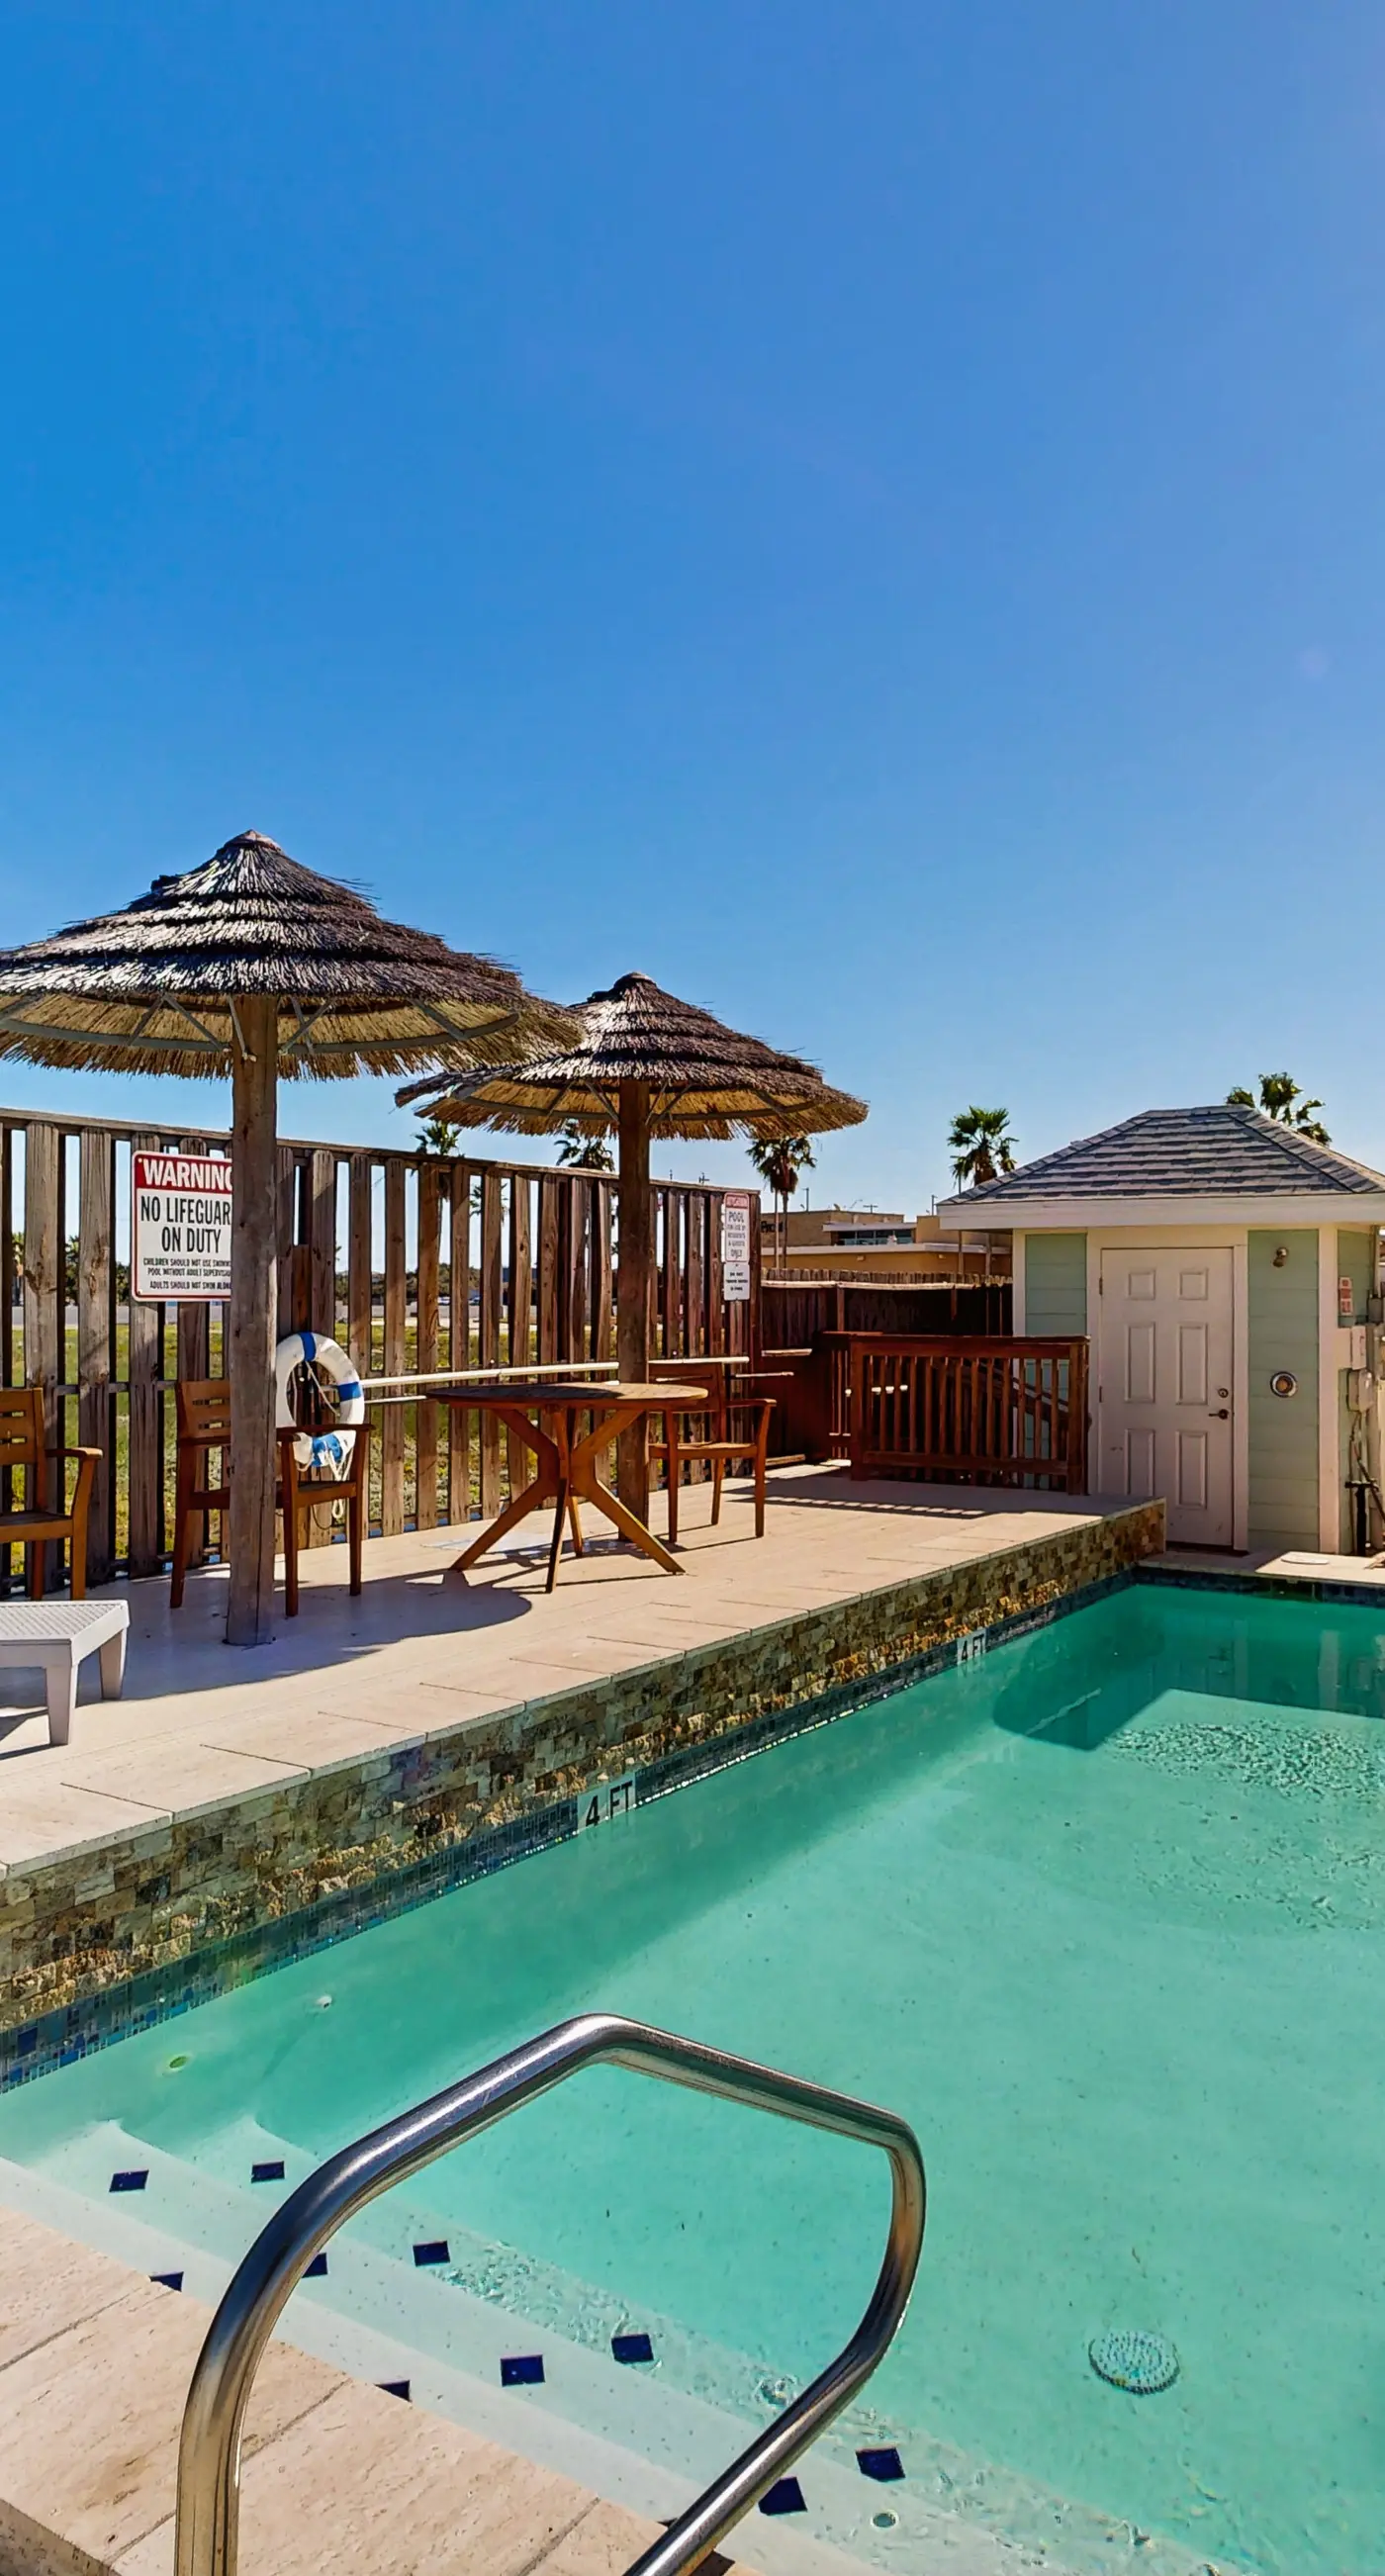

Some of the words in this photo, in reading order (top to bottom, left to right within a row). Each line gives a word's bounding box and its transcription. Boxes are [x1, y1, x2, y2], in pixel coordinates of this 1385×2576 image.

[140, 1195, 160, 1222] NO
[166, 1197, 231, 1226] LIFEGUAR
[161, 1226, 181, 1252] ON
[187, 1228, 222, 1253] DUTY
[143, 1257, 169, 1266] CHILDREN
[170, 1258, 190, 1267] SHOULD
[191, 1258, 201, 1267] NOT
[147, 1267, 161, 1276] POOL
[163, 1267, 185, 1276] WITHOUT
[149, 1280, 169, 1289] ADULTS
[170, 1281, 190, 1290] SHOULD
[972, 1633, 984, 1660] FT
[586, 1795, 600, 1826] 4
[609, 1781, 632, 1819] FT
